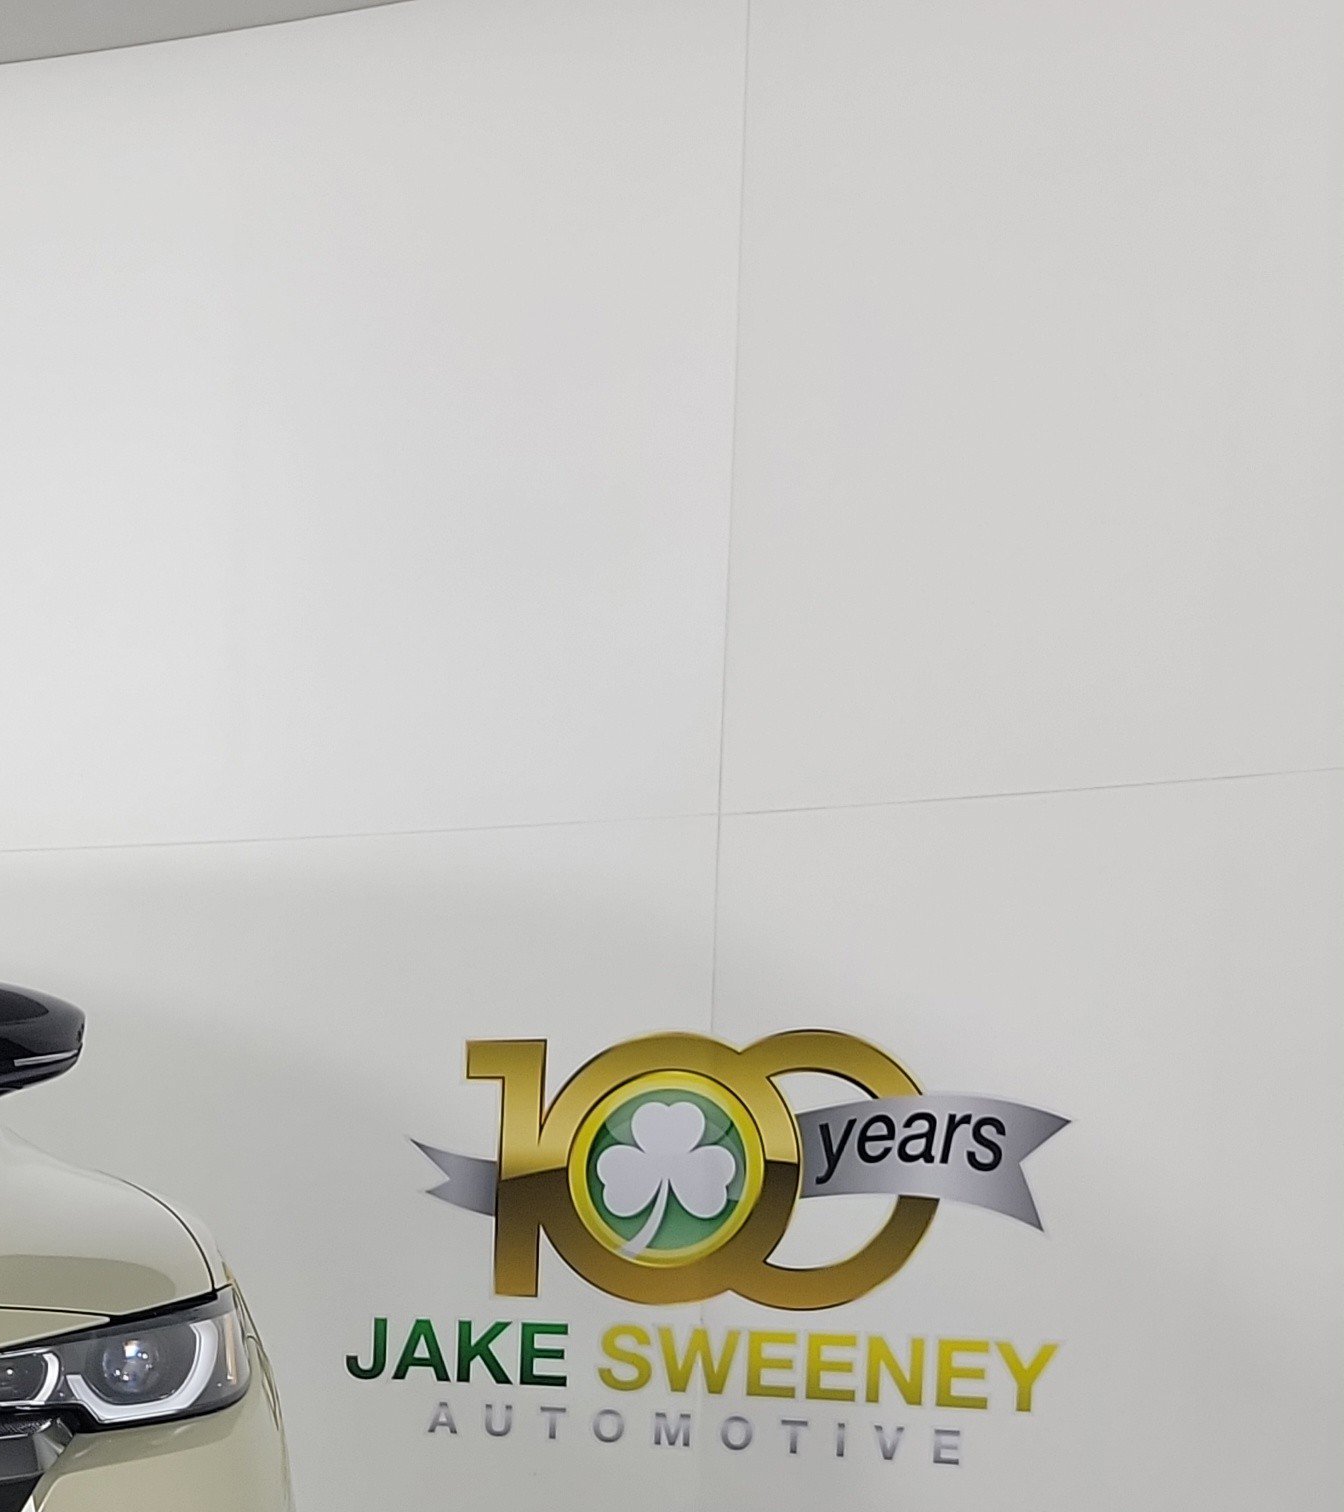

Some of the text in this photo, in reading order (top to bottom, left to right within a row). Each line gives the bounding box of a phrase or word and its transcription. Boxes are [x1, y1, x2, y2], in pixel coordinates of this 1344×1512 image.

[465, 1028, 940, 1311] 100
[814, 1111, 1008, 1185] years
[345, 1317, 1058, 1412] JAKE SWEENEY
[427, 1401, 962, 1465] AUTOMOTIVE
